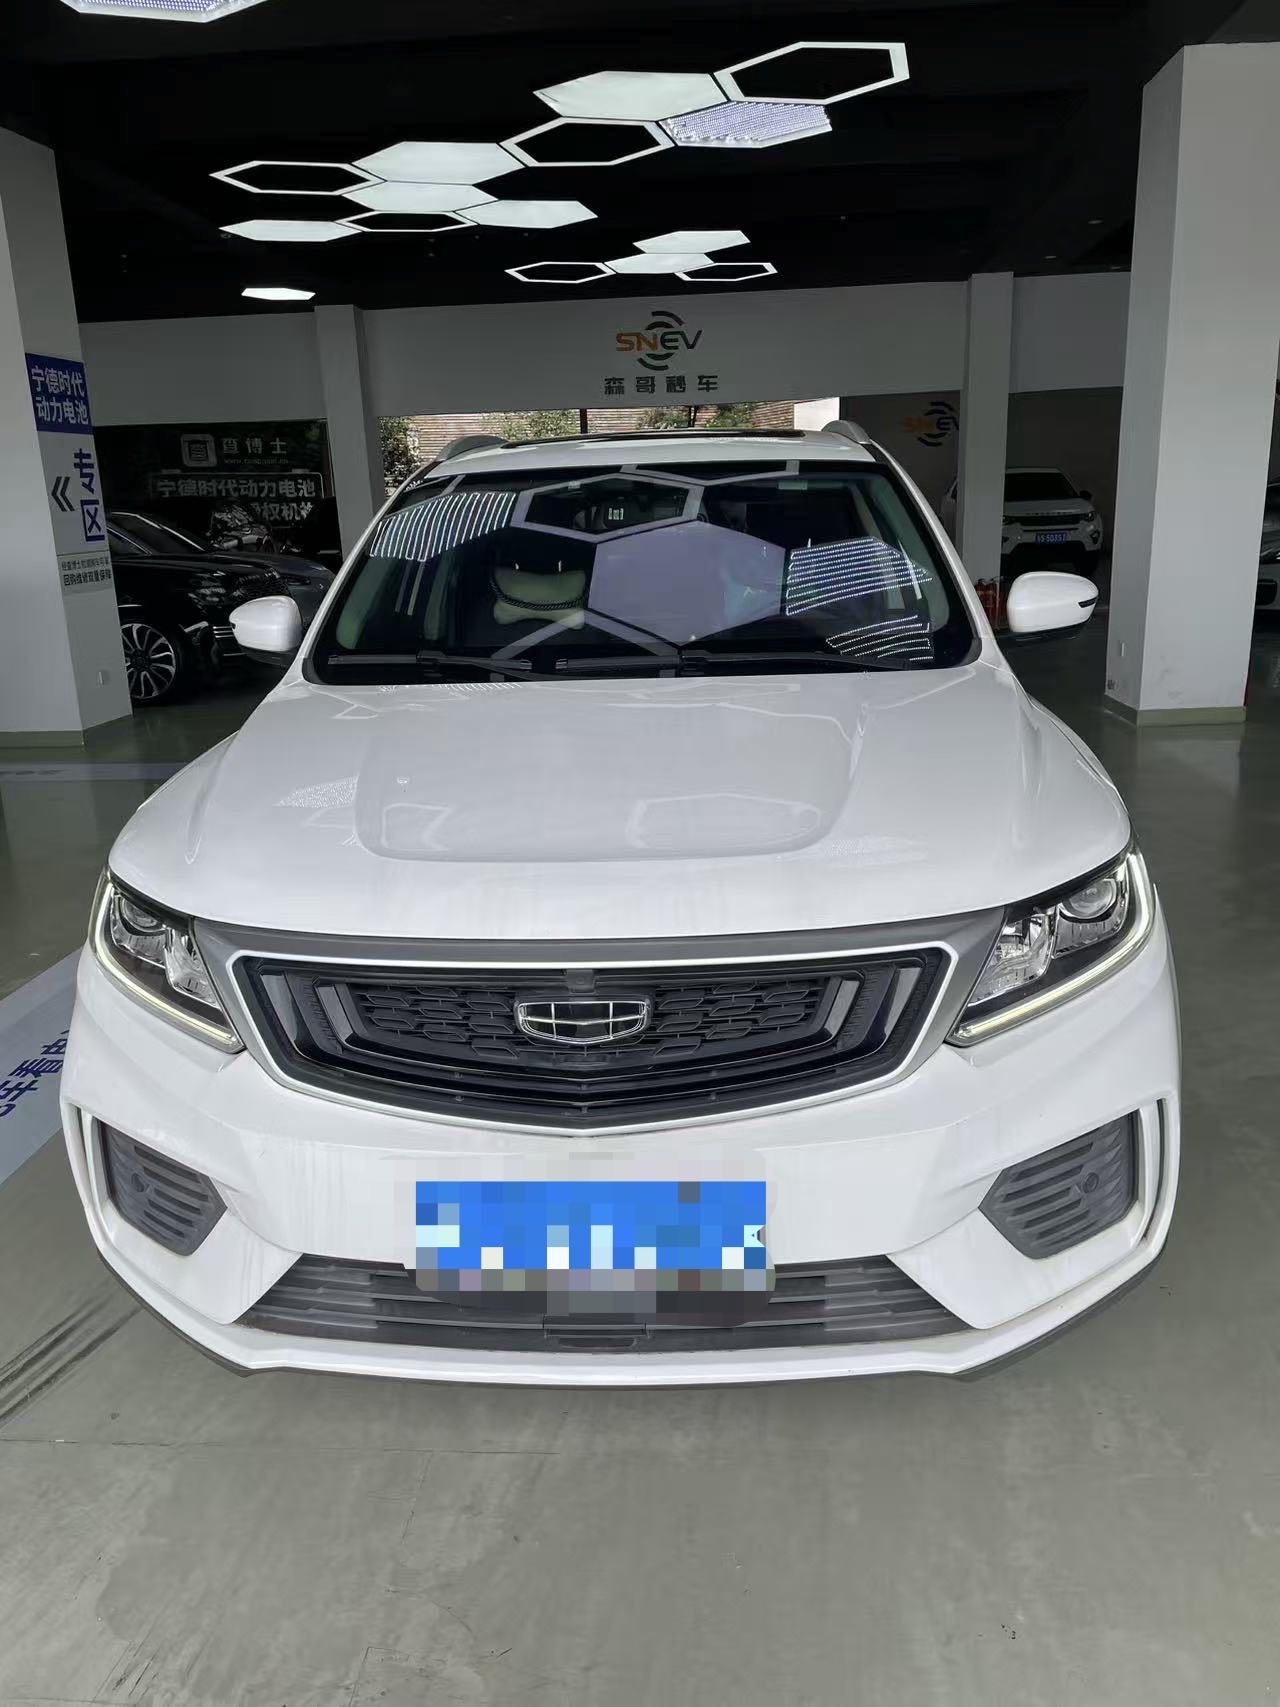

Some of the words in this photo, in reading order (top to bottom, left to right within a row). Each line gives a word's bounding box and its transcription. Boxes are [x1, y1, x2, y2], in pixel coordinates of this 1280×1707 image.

[616, 329, 702, 352] SNEV
[31, 365, 85, 397] 宁德时代
[604, 375, 718, 395] 森哥秒车
[35, 395, 89, 425] 动力电池
[73, 447, 105, 542] 专区
[157, 479, 316, 498] 宁德时代动力电池
